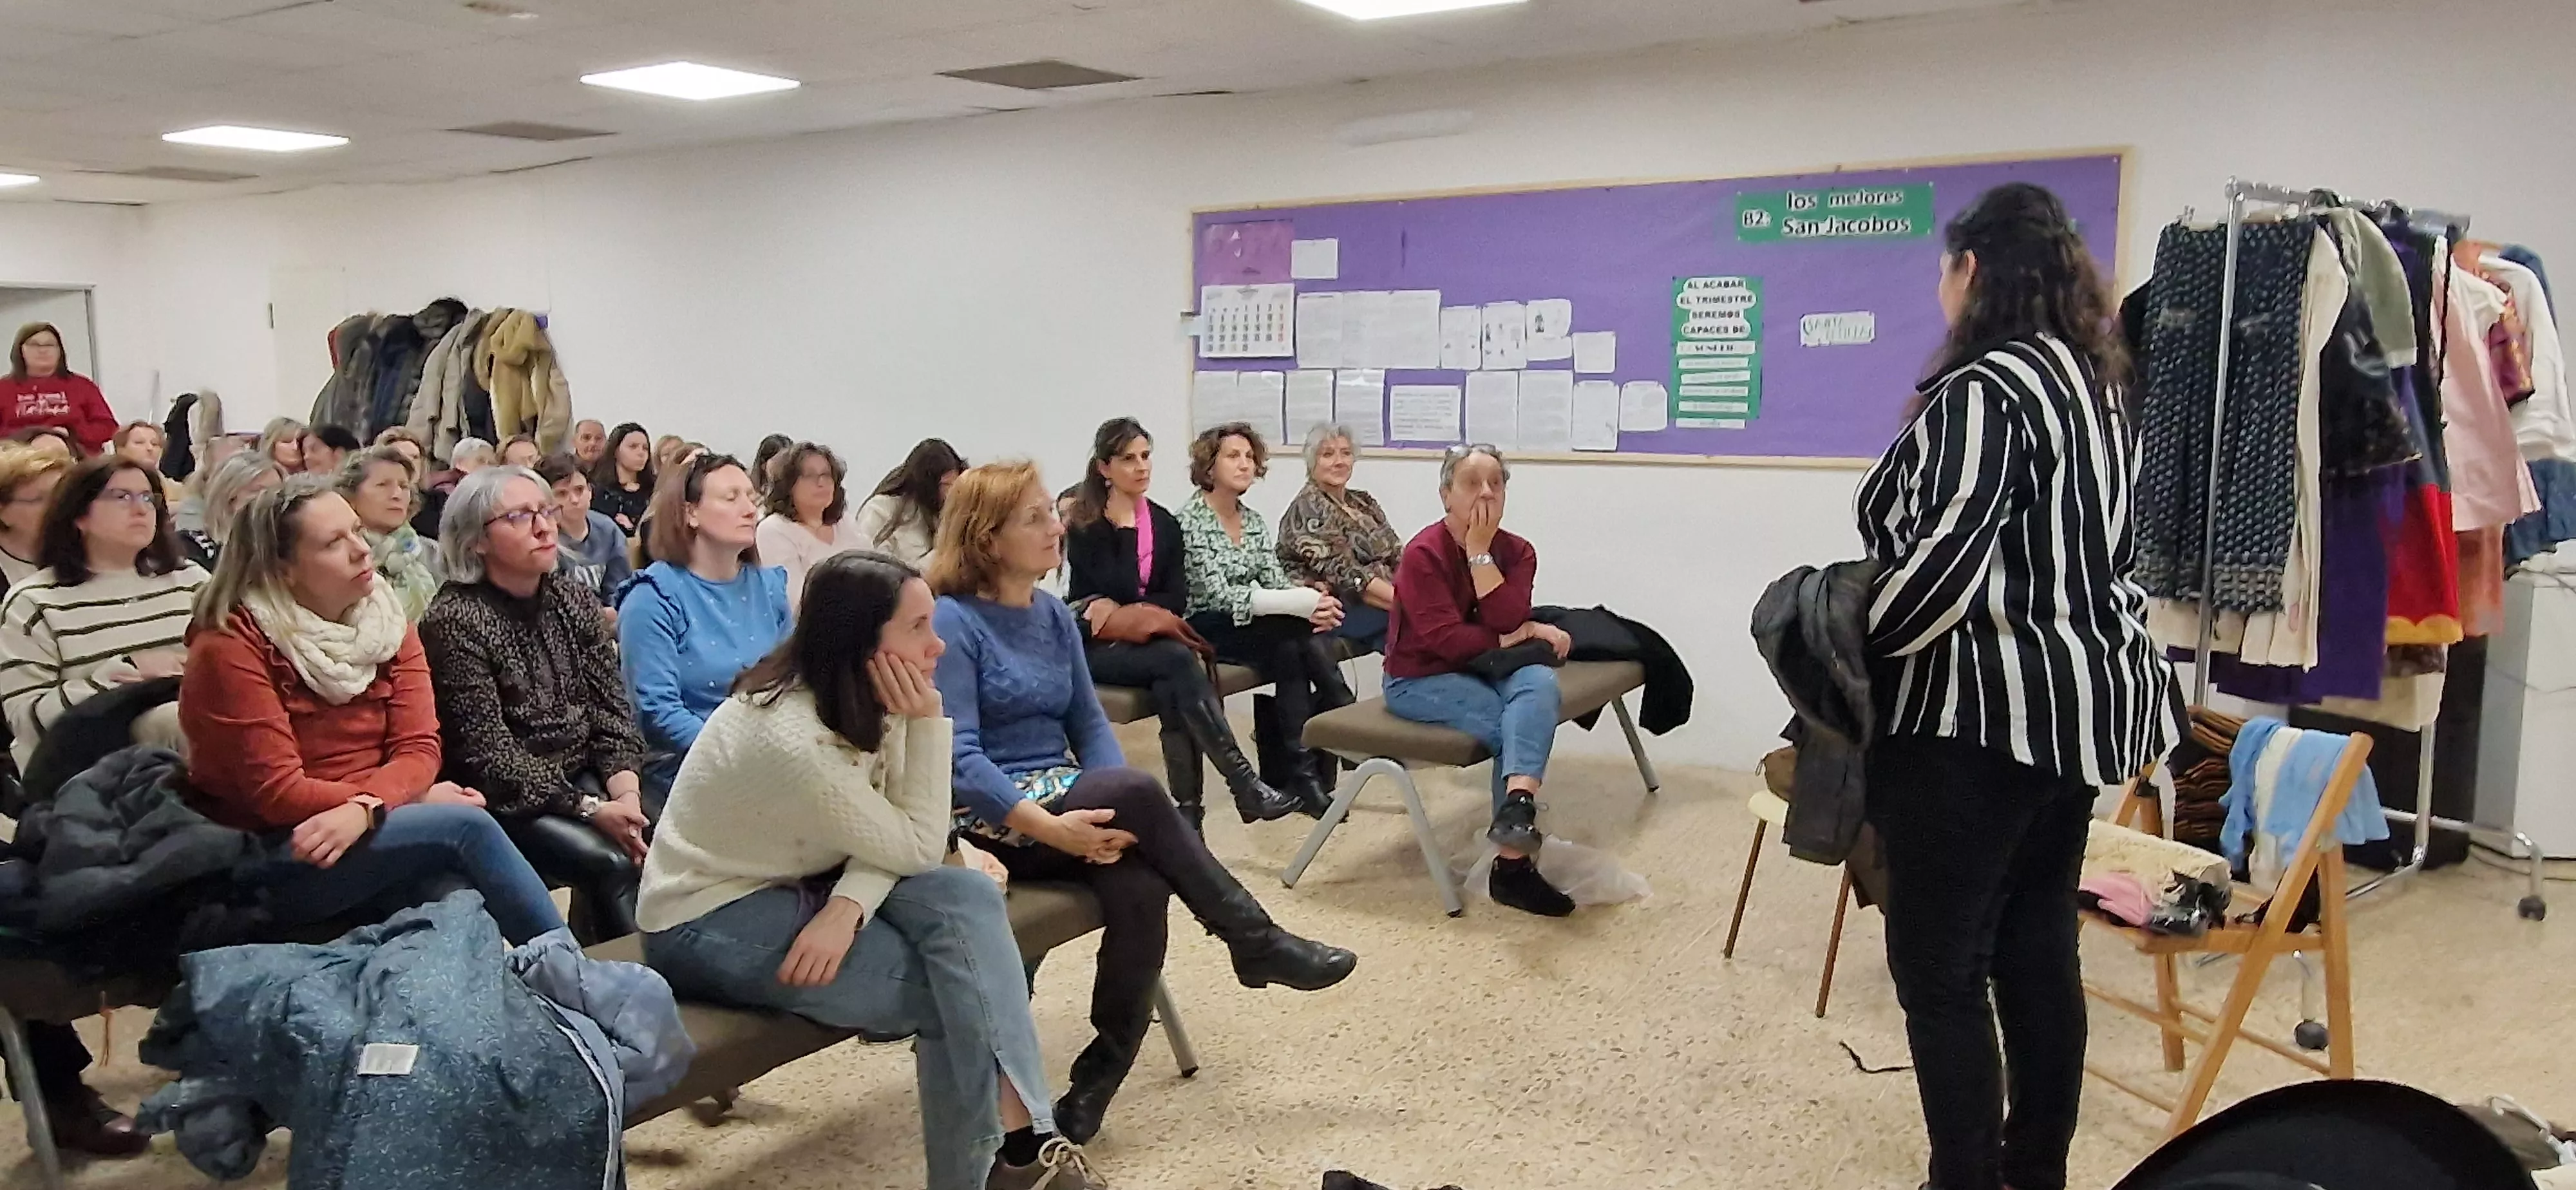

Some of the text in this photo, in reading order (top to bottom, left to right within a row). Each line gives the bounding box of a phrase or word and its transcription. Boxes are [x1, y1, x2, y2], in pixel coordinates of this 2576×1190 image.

[1786, 190, 1903, 210] los mejores
[1783, 215, 1911, 234] San Jacobos
[1687, 280, 1744, 289] AL ACABAR
[1696, 296, 1753, 304] TRIMESTRE
[1692, 310, 1740, 319] SEREMOS
